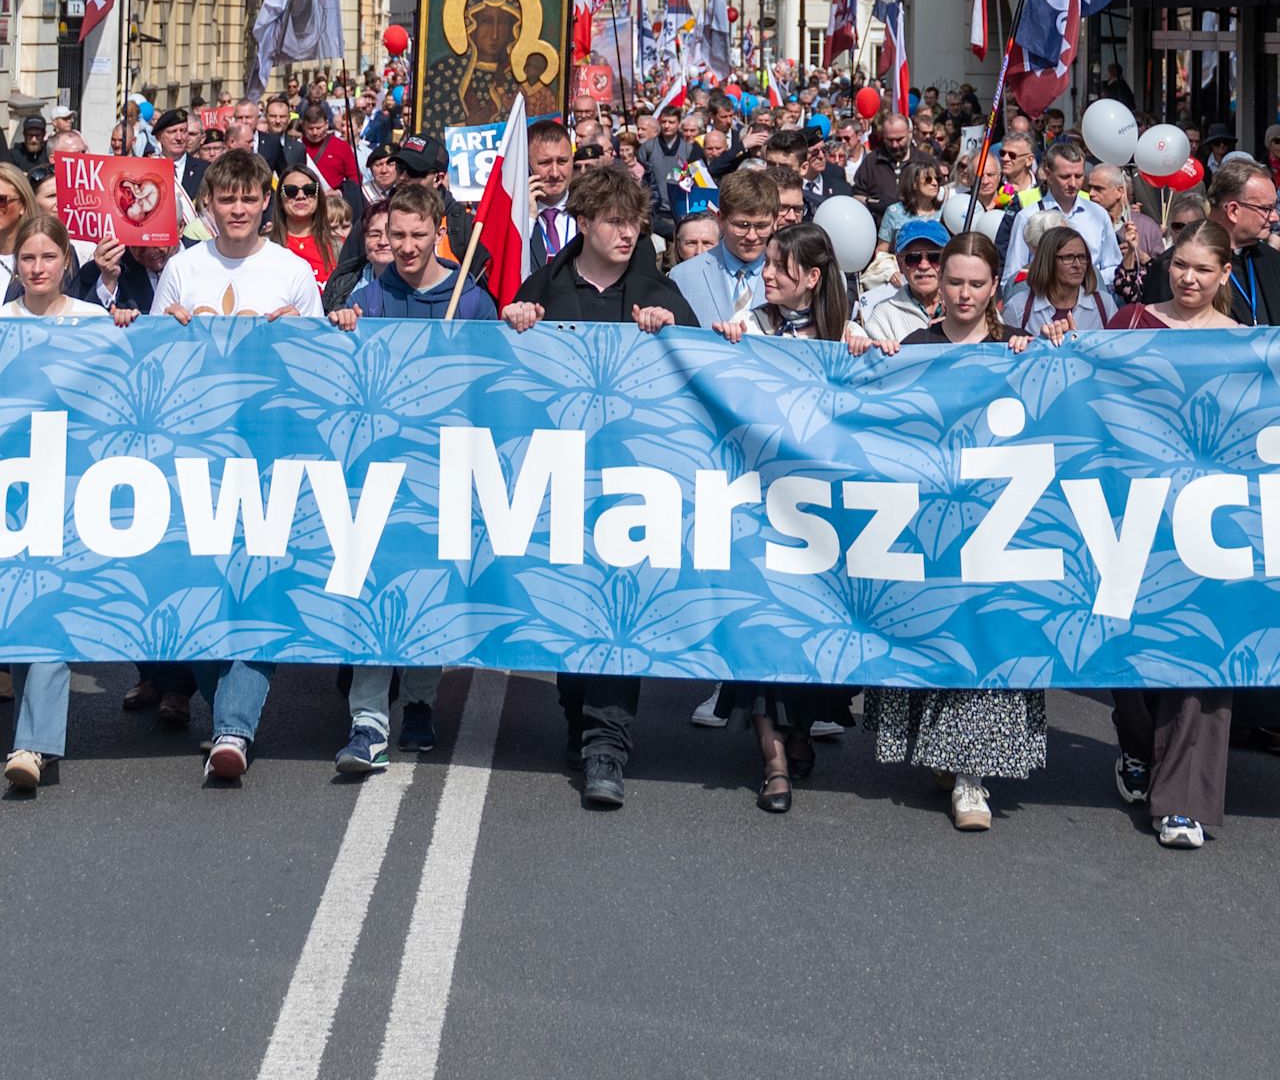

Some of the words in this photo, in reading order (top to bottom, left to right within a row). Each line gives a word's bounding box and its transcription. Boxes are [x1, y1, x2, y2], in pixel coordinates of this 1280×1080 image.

[72, 3, 81, 14] 12
[451, 130, 503, 152] ART.
[61, 157, 105, 192] TAK
[74, 189, 102, 210] dla
[63, 203, 117, 241] ŻYCIA
[436, 425, 925, 583] Marsz
